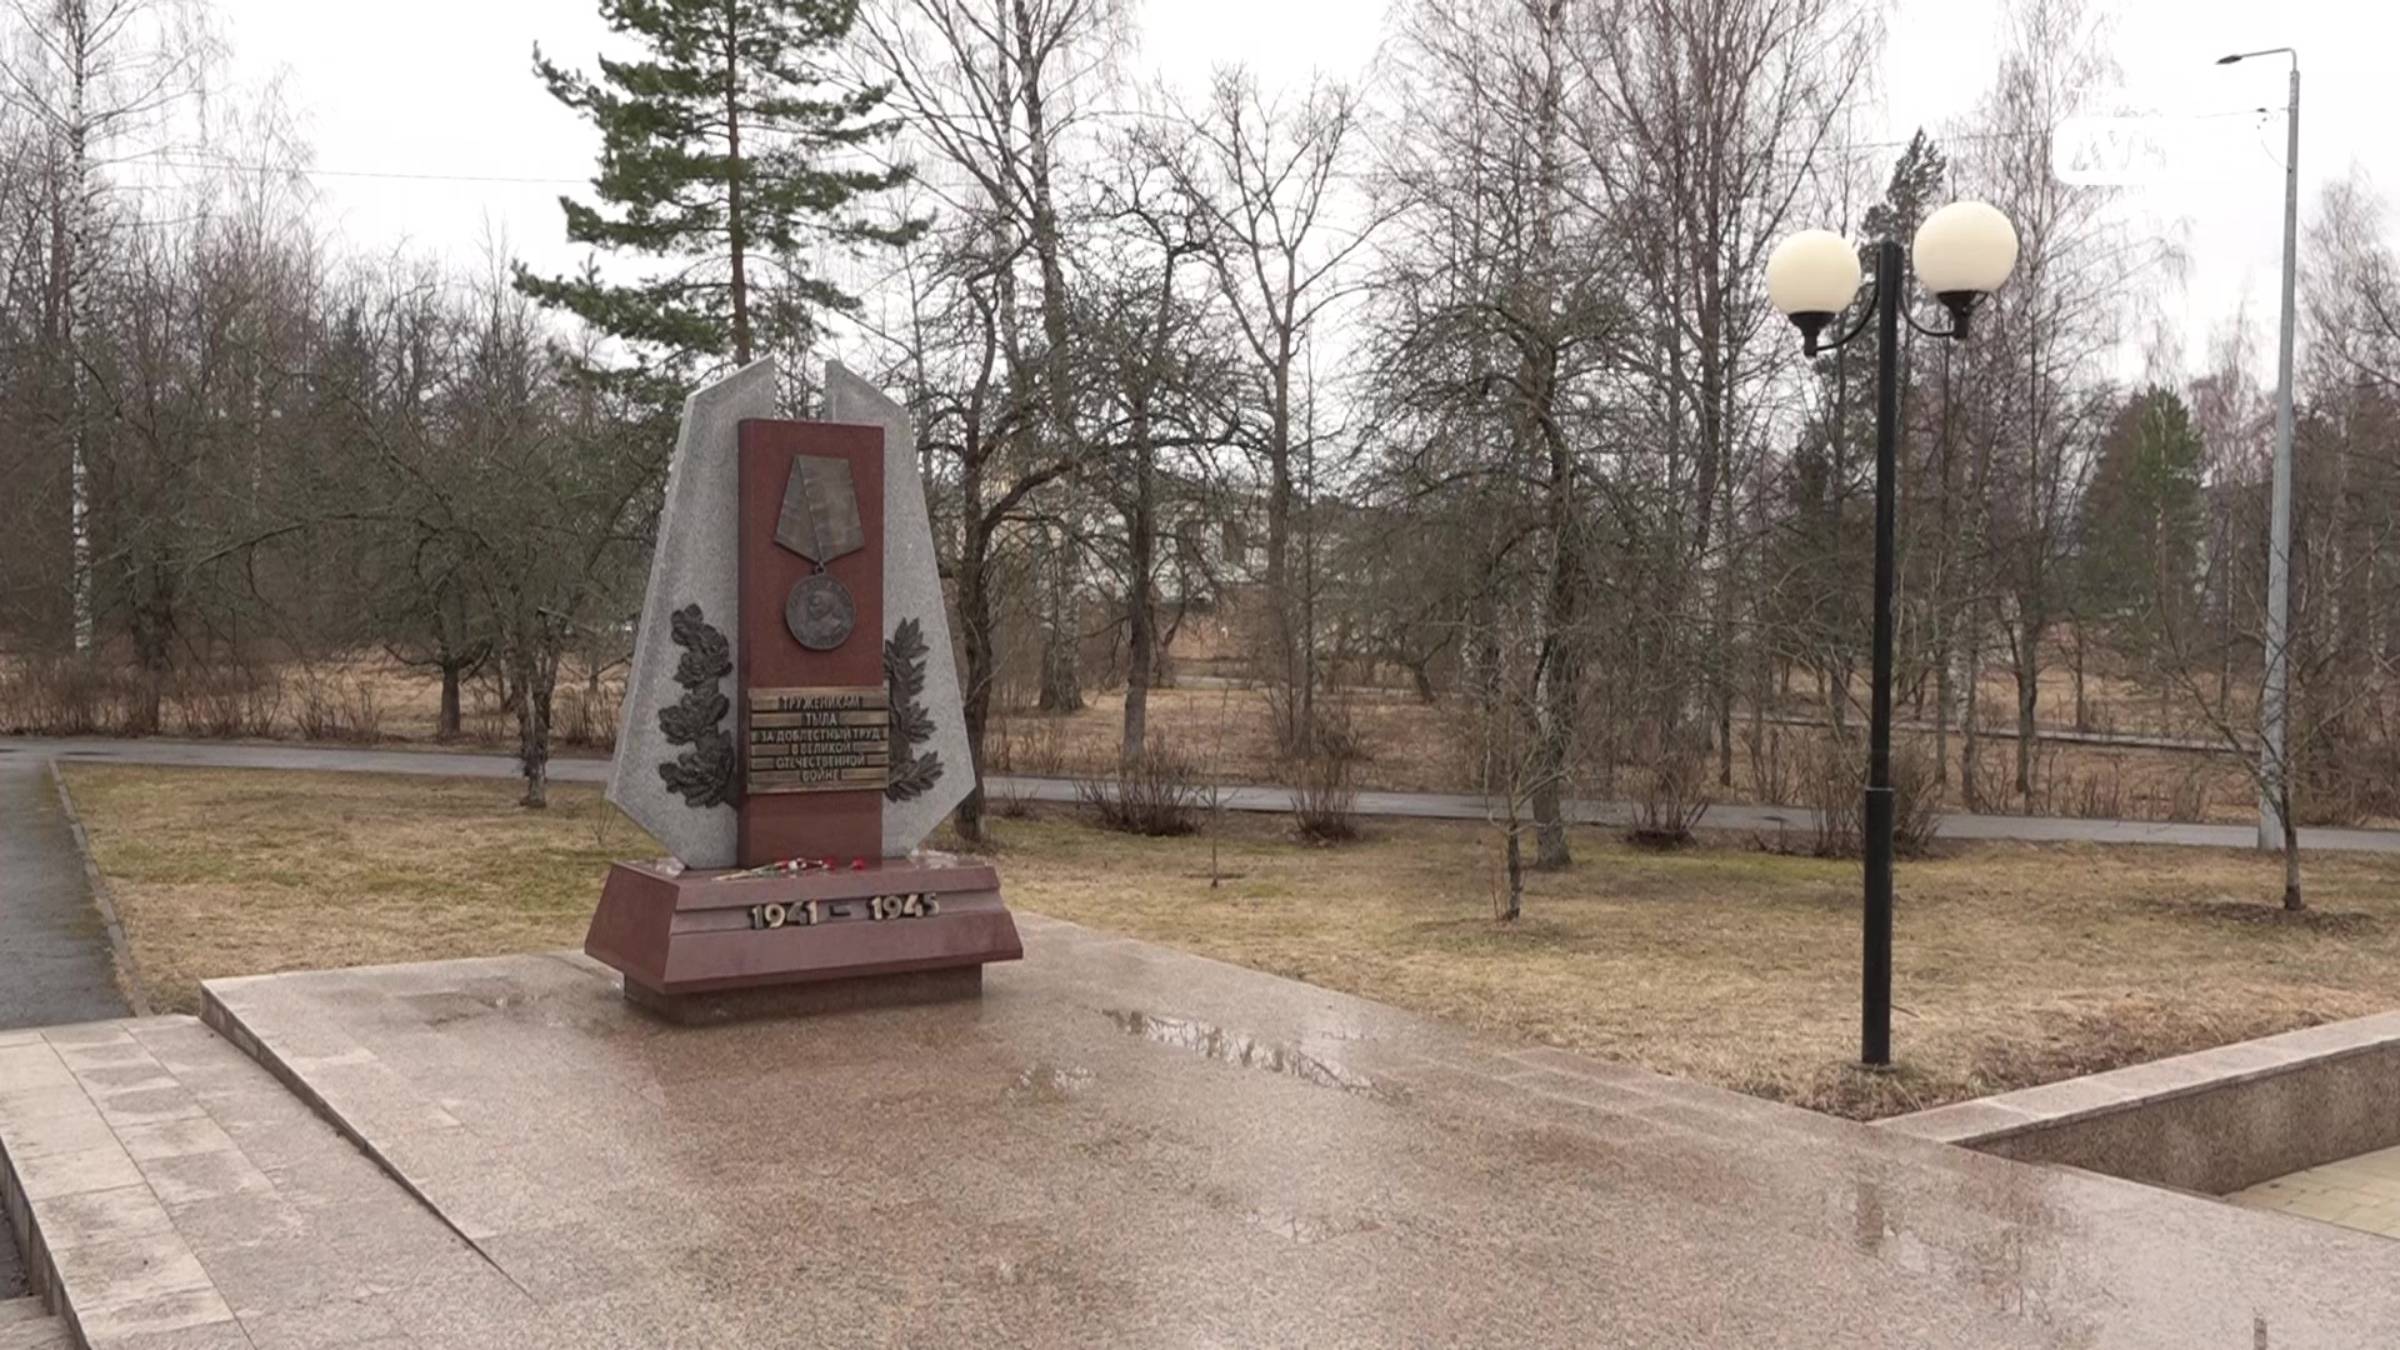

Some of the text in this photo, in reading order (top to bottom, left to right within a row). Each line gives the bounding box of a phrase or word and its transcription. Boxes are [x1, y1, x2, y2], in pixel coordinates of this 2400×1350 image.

[782, 696, 861, 710] ТРУЖЕНИКАМ
[805, 712, 837, 726] ТЫЛА
[761, 728, 880, 742] ЗА ДОБЛЕСТНЫЙ ТРУД
[791, 741, 851, 755] В ВЕЛИКОЙ
[776, 755, 865, 769] ОТЕЧЕСТВЕННОЙ
[802, 768, 840, 781] ВОЙНЕ
[752, 901, 818, 929] 1941
[870, 893, 939, 920] 1945
